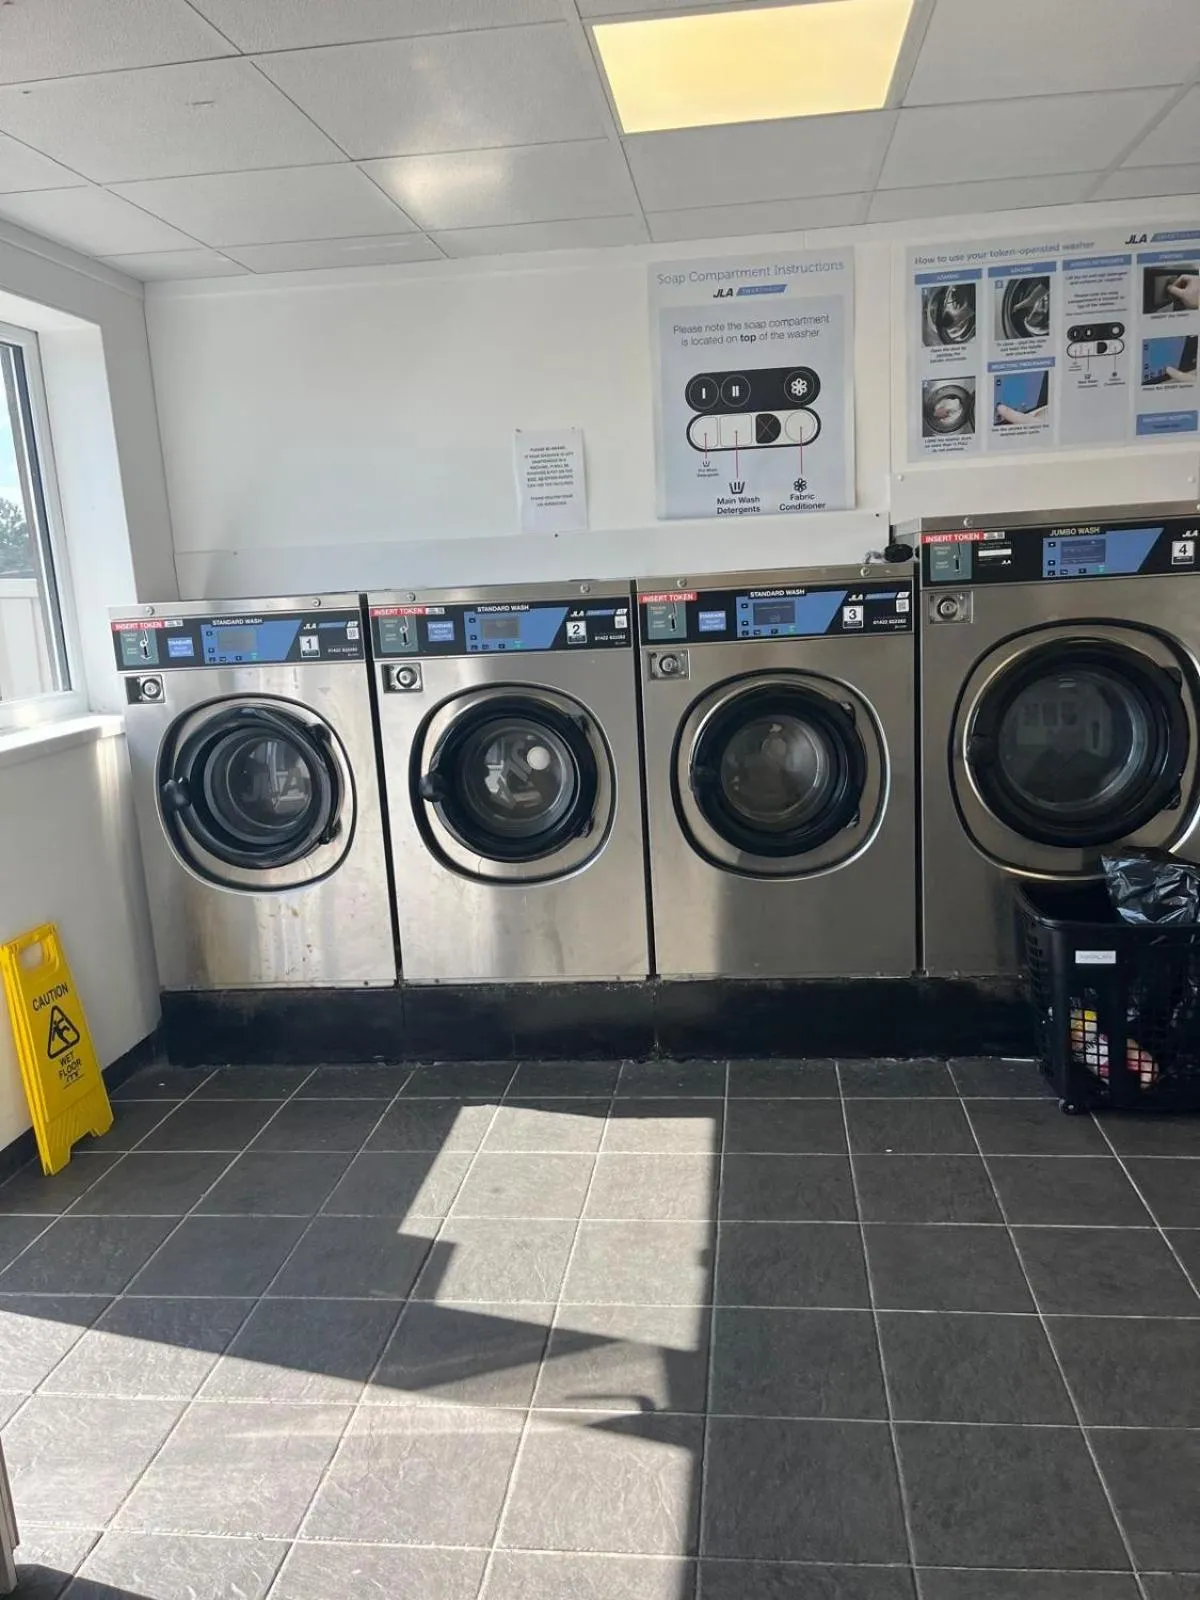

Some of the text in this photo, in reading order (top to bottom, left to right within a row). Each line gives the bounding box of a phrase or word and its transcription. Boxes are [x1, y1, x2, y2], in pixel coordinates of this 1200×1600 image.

[1124, 234, 1148, 245] JLA
[914, 256, 935, 265] How
[937, 255, 947, 263] to
[949, 254, 965, 262] use
[966, 252, 987, 261] your
[657, 260, 845, 286] Soap Compartment Instructions
[713, 288, 734, 298] JLA
[673, 314, 830, 334] Please note the soap compartment
[681, 329, 820, 347] is located on top of the washer
[716, 497, 737, 505] Main
[789, 493, 815, 501] Fabric
[716, 506, 761, 515] Detergents
[779, 502, 826, 511] Conditioner
[925, 534, 952, 542] INSERT
[954, 533, 980, 541] TOKEN
[1182, 530, 1198, 538] JLA
[1179, 544, 1187, 555] 4
[642, 593, 695, 602] INSERT TOKEN
[750, 590, 784, 598] STANDARD
[374, 608, 398, 616] INSERT
[399, 607, 423, 615] TOKEN
[477, 605, 510, 613] STANDARD
[849, 609, 857, 620] 3
[115, 621, 138, 630] INSERT
[140, 620, 162, 629] TOKEN
[212, 618, 243, 626] STANDARD
[572, 624, 580, 635] 2
[306, 638, 312, 649] 1
[32, 983, 69, 1012] CAUTION
[59, 1051, 75, 1067] WET
[58, 1058, 83, 1080] FLOOR
